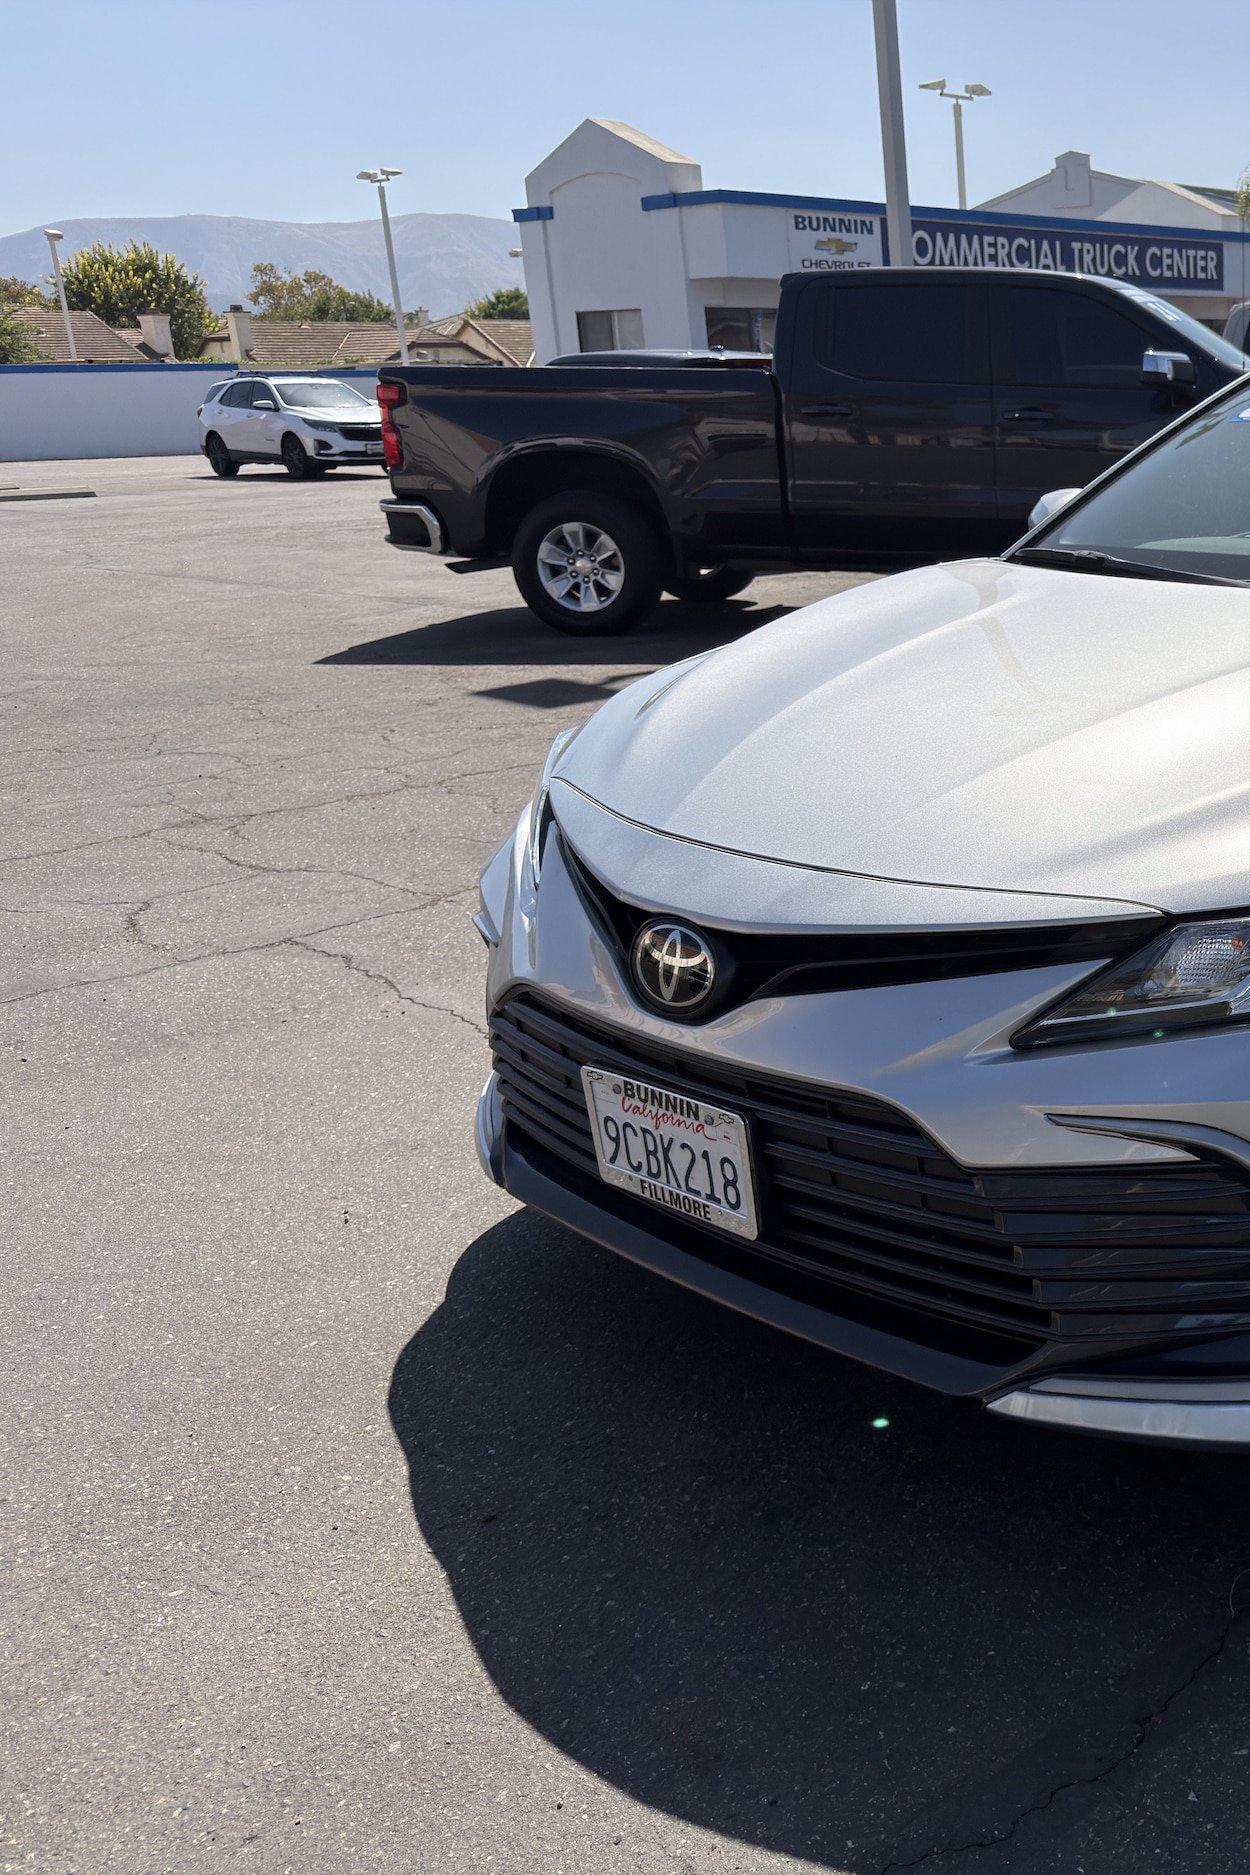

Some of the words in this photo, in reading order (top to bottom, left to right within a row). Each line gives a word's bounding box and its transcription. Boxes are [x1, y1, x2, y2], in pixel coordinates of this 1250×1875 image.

[794, 214, 874, 235] BUNNIN
[801, 258, 873, 270] CHEVROLET
[912, 230, 1066, 272] OMMERCIAL
[1071, 241, 1140, 276] TRUCK
[1145, 246, 1218, 280] CENTER
[621, 1096, 718, 1142] California
[623, 1080, 700, 1121] BUNNIN
[603, 1115, 741, 1211] 9CBK218
[640, 1179, 712, 1222] FILLMORE
